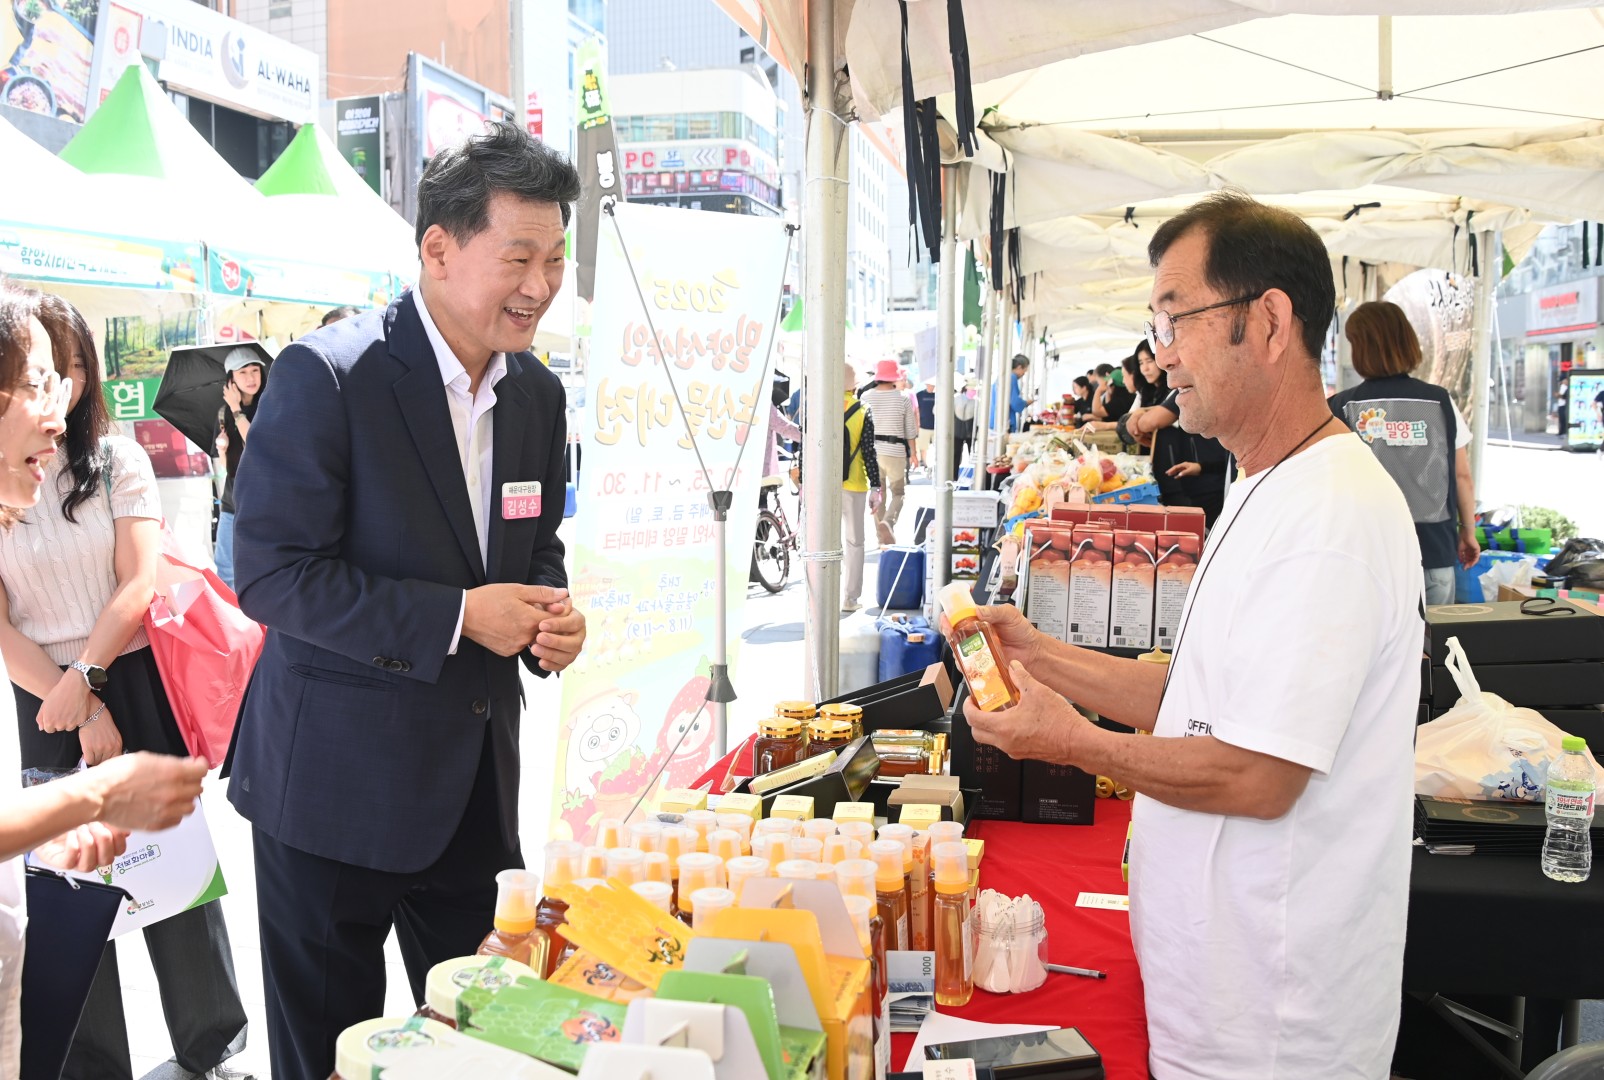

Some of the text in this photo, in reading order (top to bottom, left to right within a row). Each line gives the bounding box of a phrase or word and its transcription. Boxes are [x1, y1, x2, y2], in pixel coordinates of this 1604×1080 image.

[171, 26, 214, 60] INDIA
[257, 59, 312, 94] AL-WAHA
[625, 151, 655, 169] PC
[222, 266, 241, 284] 34
[111, 381, 145, 419] 협
[1385, 420, 1427, 439] 밀양팜
[507, 499, 538, 516] 김성수
[922, 955, 933, 977] 1000
